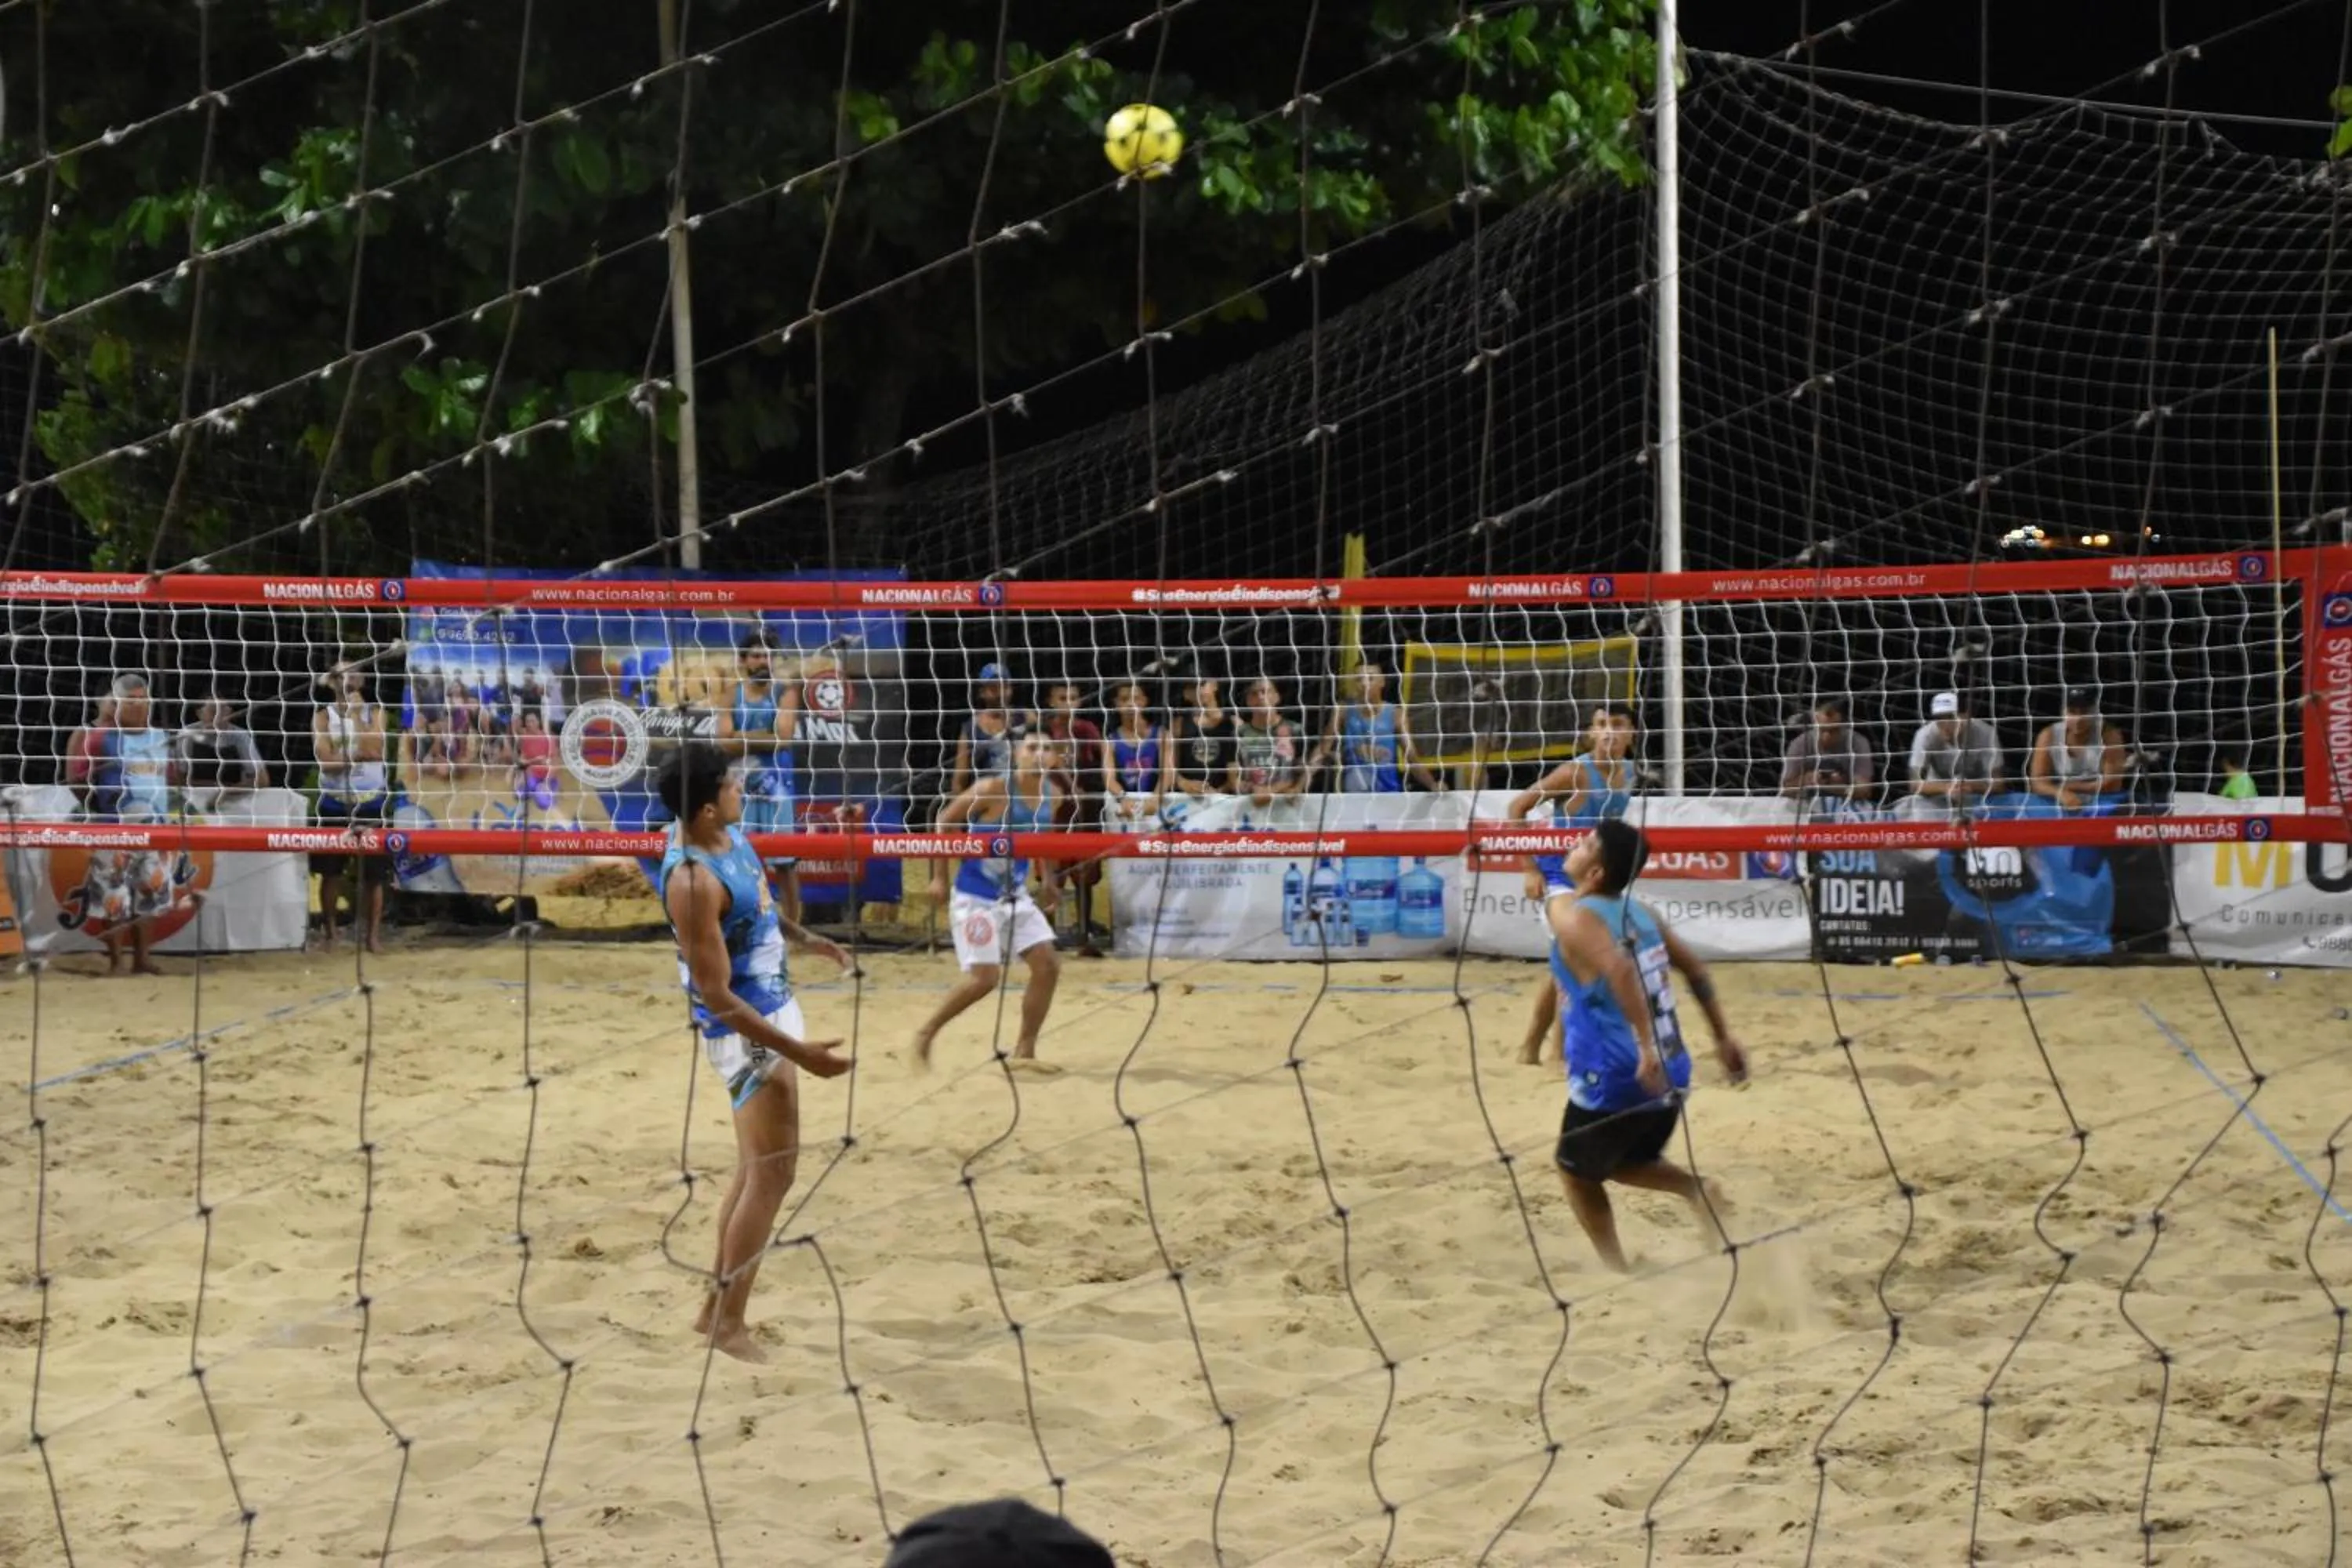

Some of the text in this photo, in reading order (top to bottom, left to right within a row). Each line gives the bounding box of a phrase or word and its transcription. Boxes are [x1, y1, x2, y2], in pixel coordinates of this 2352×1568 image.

[263, 580, 375, 598] NACIONALGÁS
[862, 585, 973, 602] NACIONALGÁS
[1468, 577, 1582, 597] NACIONALGÁS
[2116, 819, 2238, 840] NACIONALGÁS
[873, 837, 984, 853] NACIONALGÁS
[1969, 877, 2023, 889] sports
[1820, 877, 1905, 916] IDEIA!
